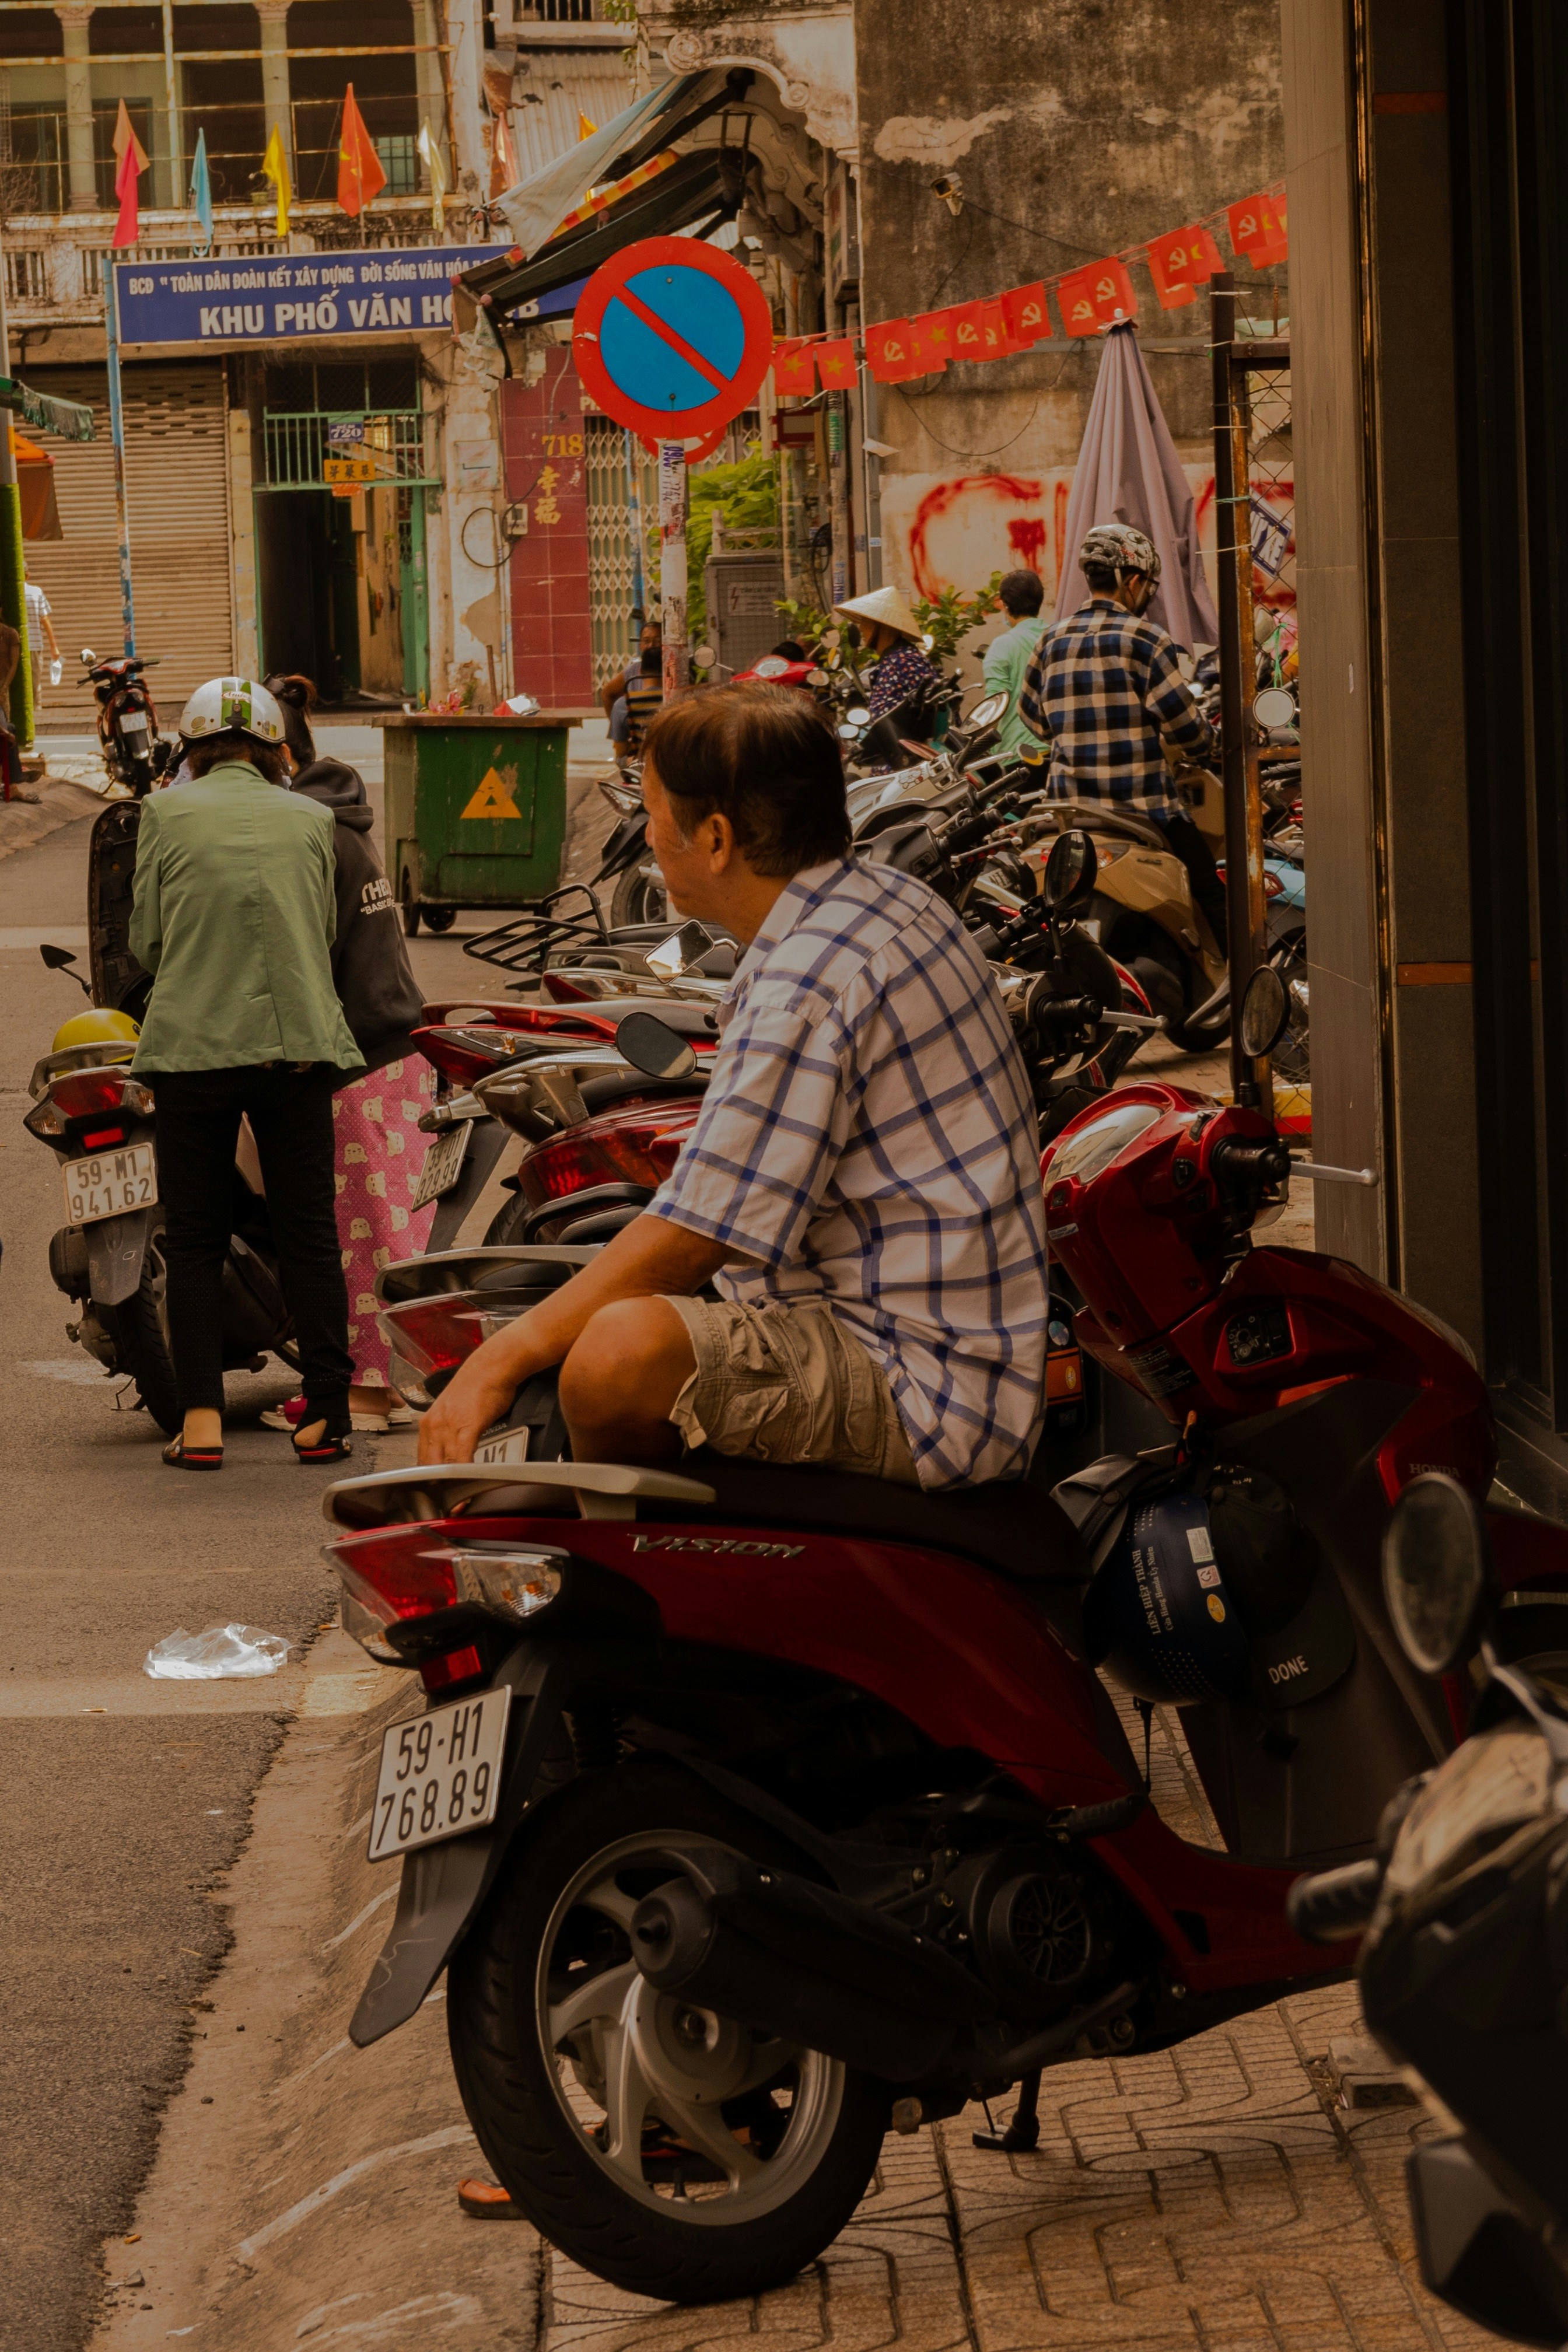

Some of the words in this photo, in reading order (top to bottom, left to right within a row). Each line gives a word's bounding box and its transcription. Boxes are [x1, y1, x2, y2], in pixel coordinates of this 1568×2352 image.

[130, 277, 154, 295] BCĐ
[205, 270, 230, 291] DÂN
[233, 268, 265, 289] ĐOÀN
[268, 265, 292, 288] KẾT
[295, 265, 318, 286] XÂY
[321, 265, 354, 288] DỰNG
[360, 261, 383, 282] ĐỜI
[384, 258, 417, 281] SỐNG
[418, 260, 443, 279] VĂN
[200, 304, 264, 335] KHU
[275, 289, 340, 332] PHỐ
[348, 292, 412, 327] VĂN
[330, 428, 362, 439] 720
[541, 434, 583, 456] 718
[76, 1152, 137, 1188] 59-M1
[416, 1158, 459, 1203] 329.99
[72, 1177, 150, 1219] 941.62
[1408, 1463, 1461, 1479] HONDA
[626, 1533, 807, 1558] VISION
[1132, 1549, 1146, 1583] THÀNH
[1139, 1584, 1154, 1609] HIỆP
[1152, 1576, 1163, 1598] Honda
[1146, 1609, 1162, 1635] LIÊN
[1268, 1655, 1309, 1685] DONE
[397, 1701, 484, 1780] 59-H1
[375, 1762, 490, 1850] 768.89
